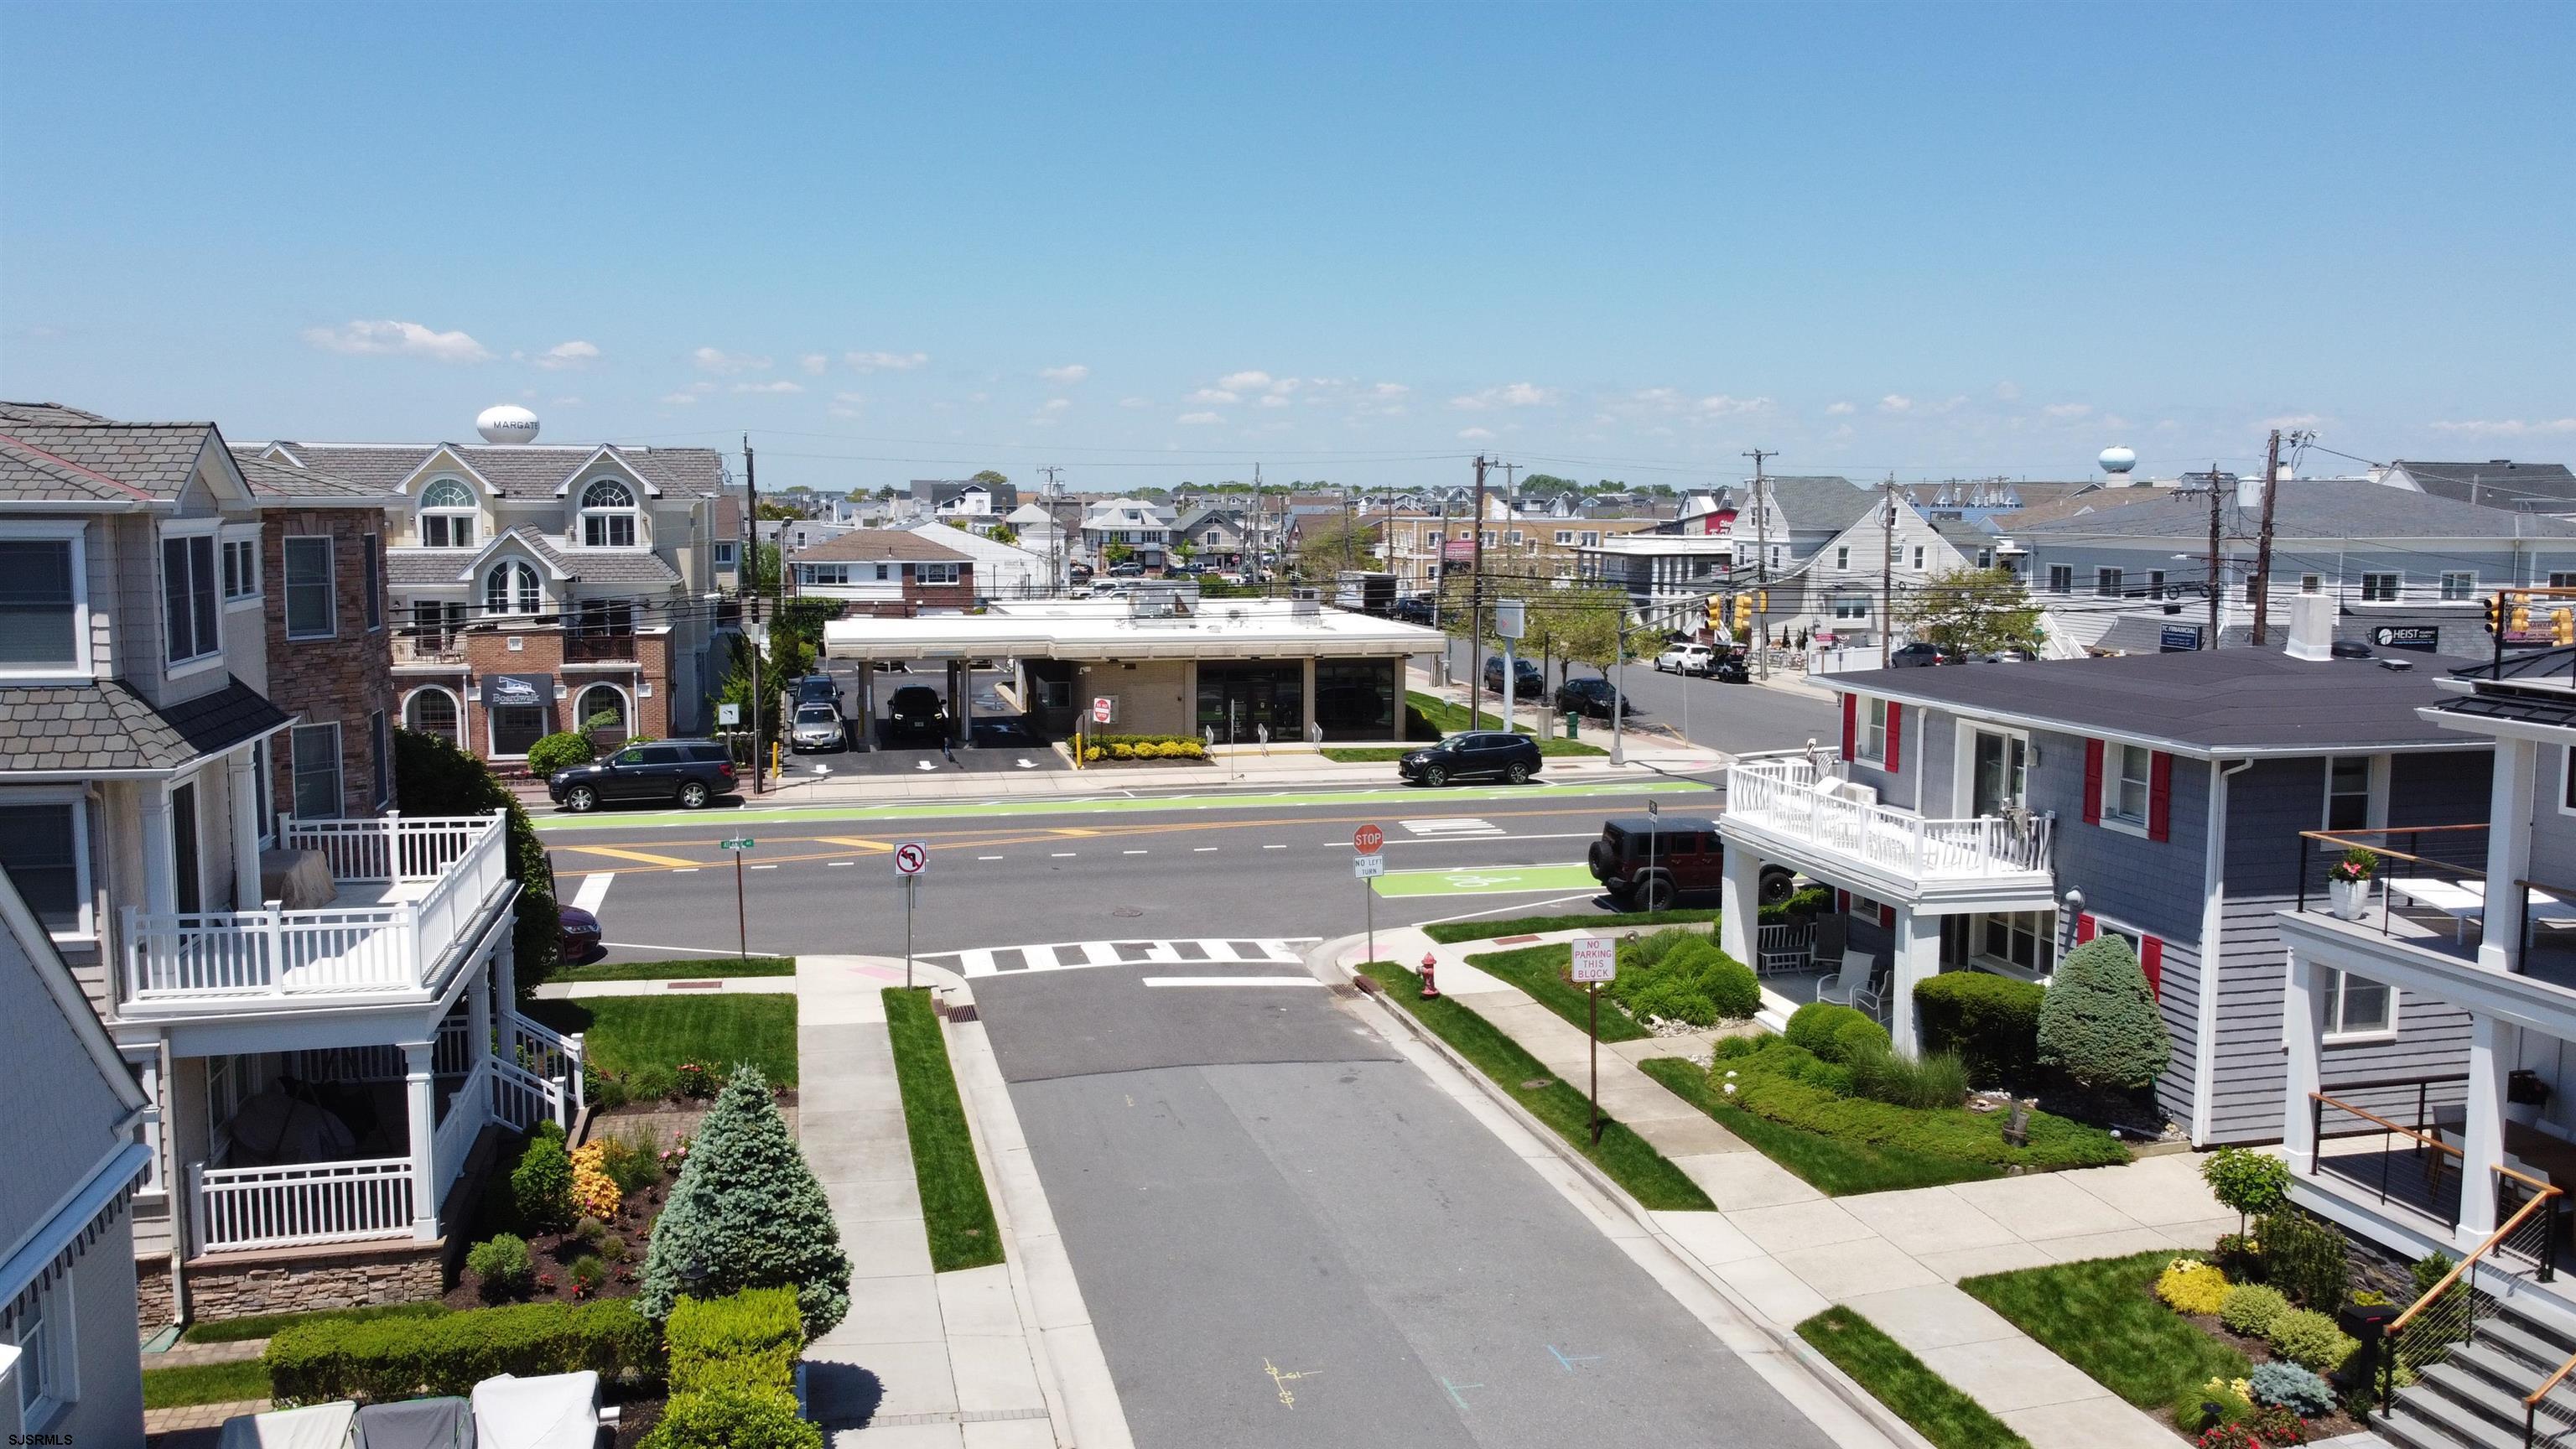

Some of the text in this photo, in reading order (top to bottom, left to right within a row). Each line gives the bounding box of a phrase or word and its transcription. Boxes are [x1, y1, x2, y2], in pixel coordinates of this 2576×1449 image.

[493, 421, 538, 429] MARGATE
[2393, 629, 2419, 638] HEIST
[492, 693, 539, 702] Boardwalk
[1355, 833, 1381, 846] STOP
[1575, 950, 1612, 958] PARKING
[1578, 969, 1608, 978] BLOCK
